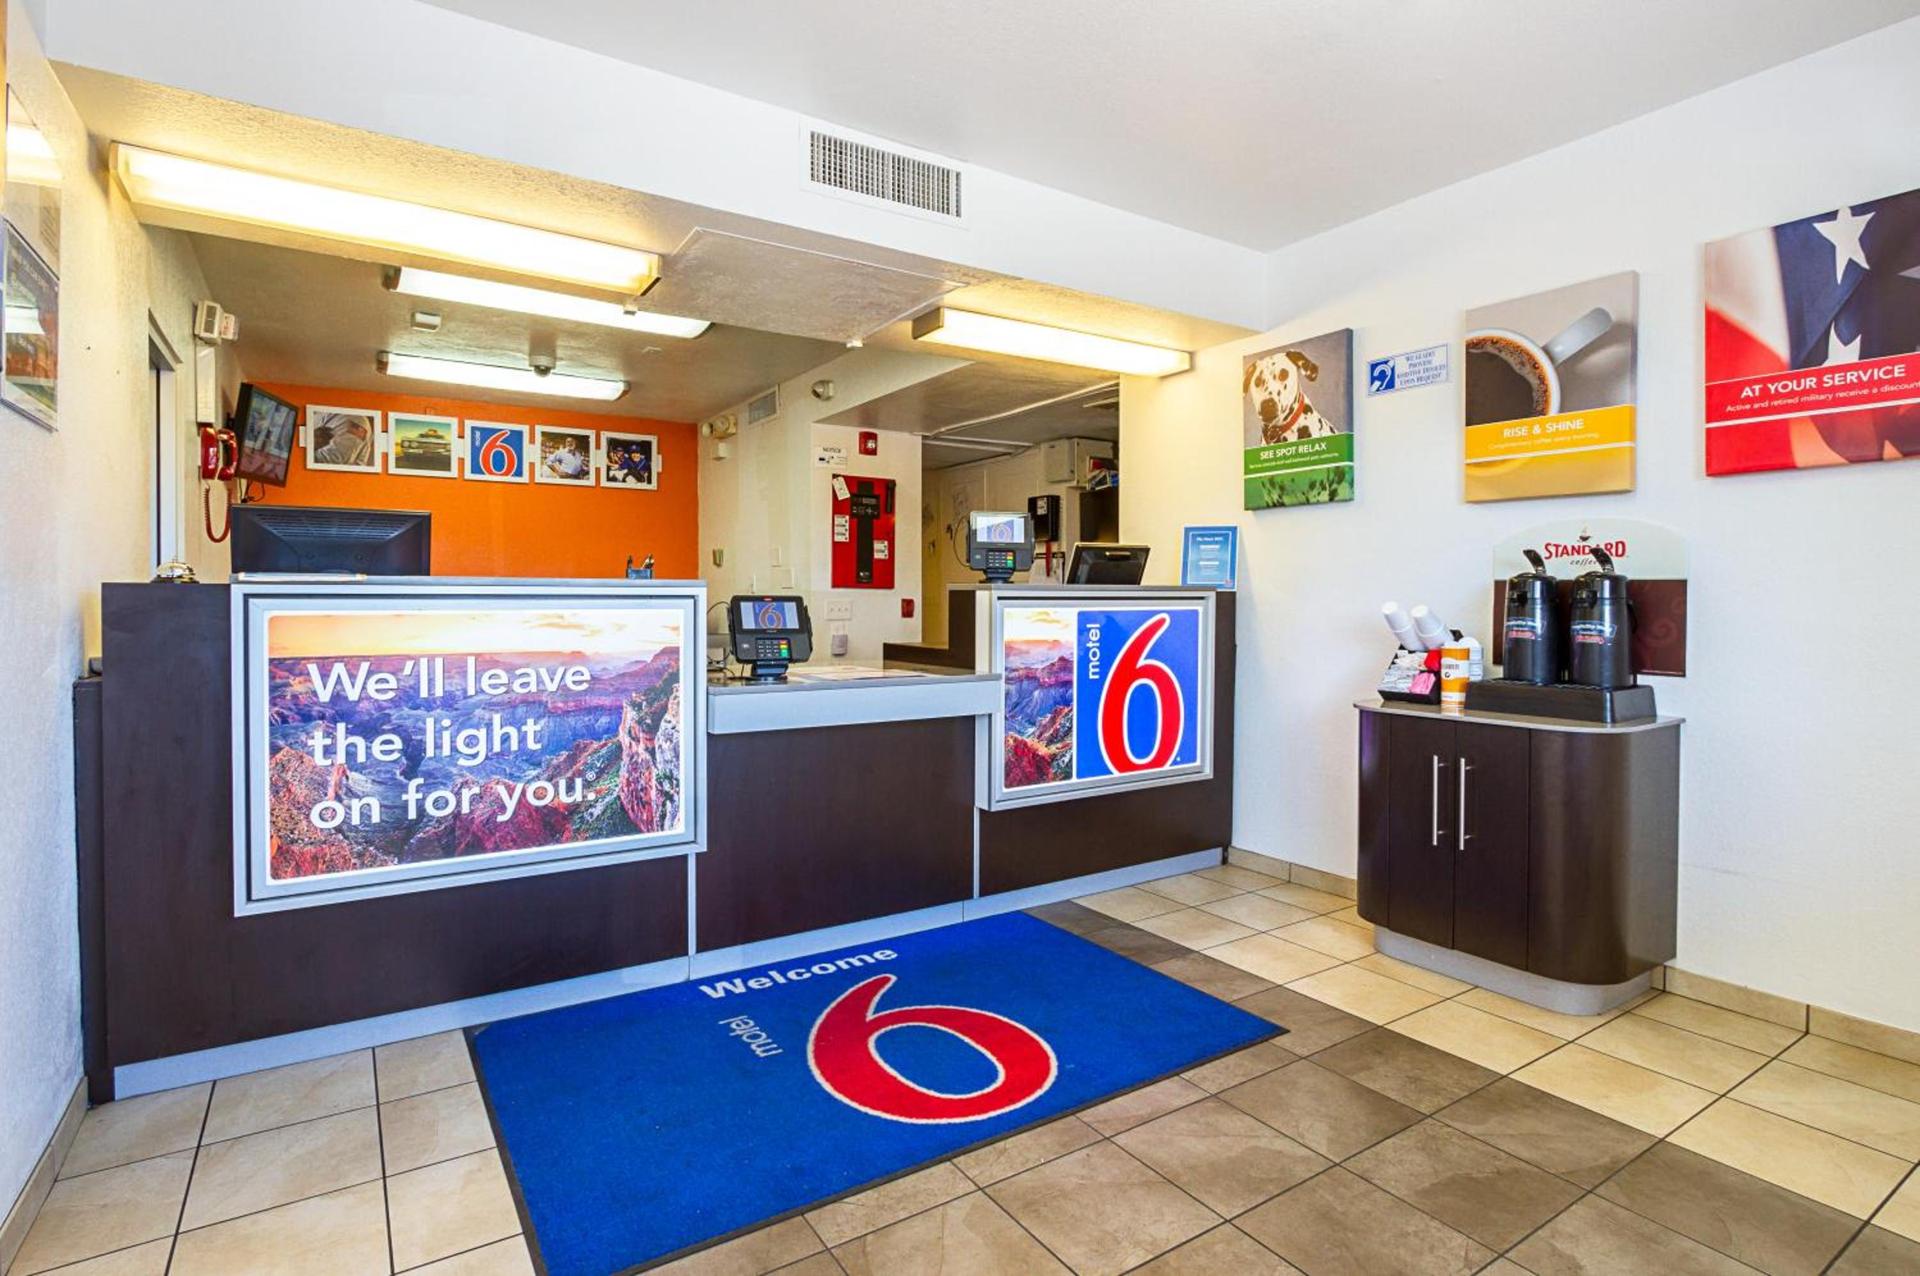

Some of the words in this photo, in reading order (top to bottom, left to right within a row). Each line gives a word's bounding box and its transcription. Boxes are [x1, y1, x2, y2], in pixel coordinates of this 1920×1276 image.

[1740, 384, 1763, 399] AT
[1768, 377, 1817, 394] YOUR
[1823, 364, 1906, 387] SERVICE
[1753, 400, 1768, 409] and
[1260, 450, 1274, 460] SEE
[1276, 446, 1297, 457] SPOT
[1298, 442, 1327, 454] RELAX
[1503, 426, 1529, 438] RISE
[1532, 424, 1542, 435] &
[1546, 418, 1585, 433] SHINE
[479, 430, 518, 477] 6
[1543, 541, 1626, 560] STANDRD
[1086, 623, 1101, 680] motel
[307, 657, 444, 703] We'll
[468, 656, 591, 696] leave
[1098, 612, 1185, 776] 6
[309, 722, 402, 767] the
[426, 713, 541, 768] light
[309, 795, 381, 829] on
[402, 777, 482, 820] for
[698, 947, 898, 1000] Welcome
[719, 1014, 784, 1058] motel
[806, 973, 1058, 1125] 6
